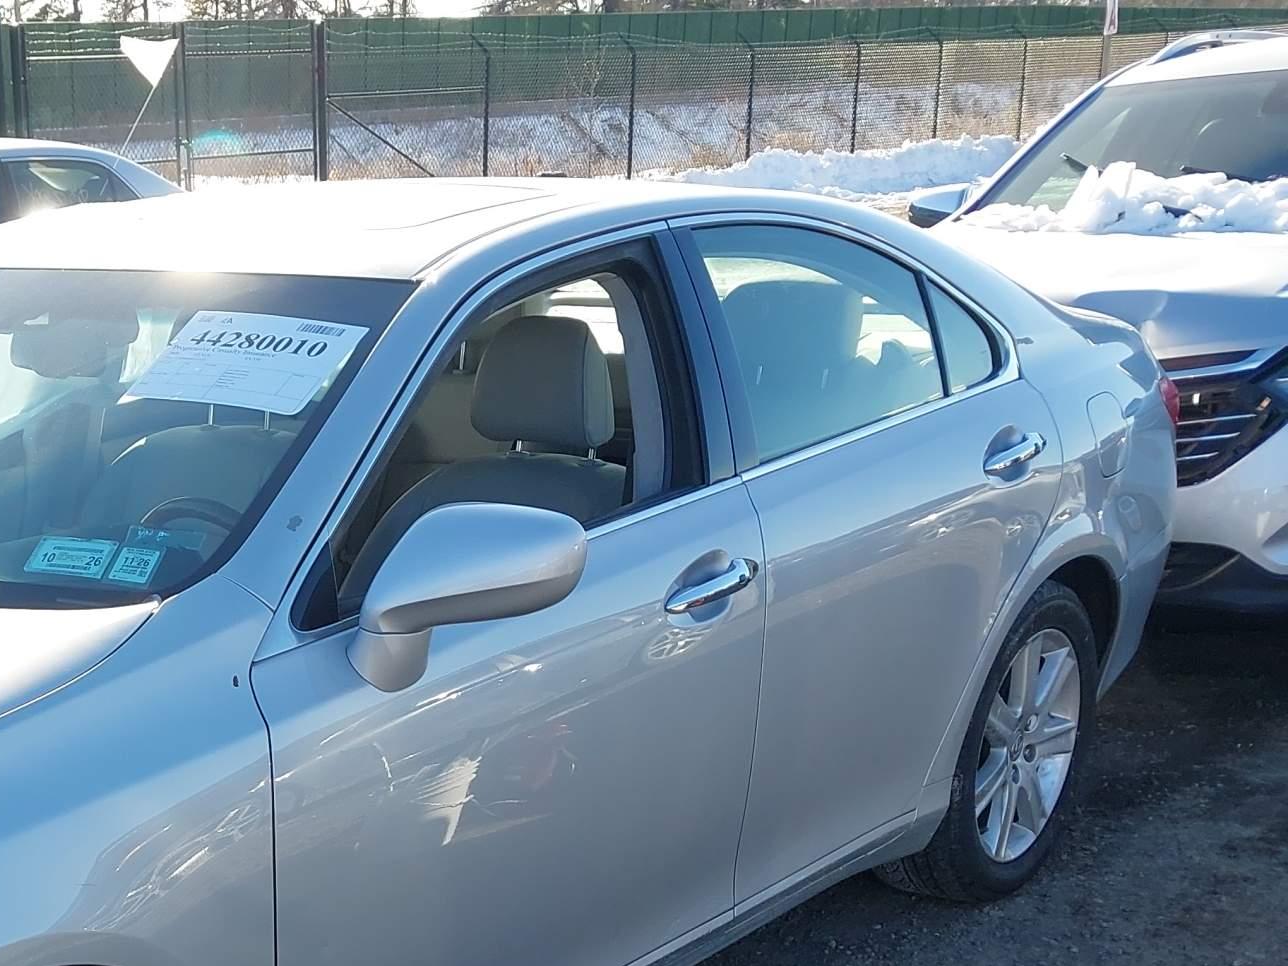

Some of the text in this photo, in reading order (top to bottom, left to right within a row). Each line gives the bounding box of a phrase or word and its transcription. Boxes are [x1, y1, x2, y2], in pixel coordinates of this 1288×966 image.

[191, 329, 328, 358] 44280010
[42, 551, 103, 566] 10 26
